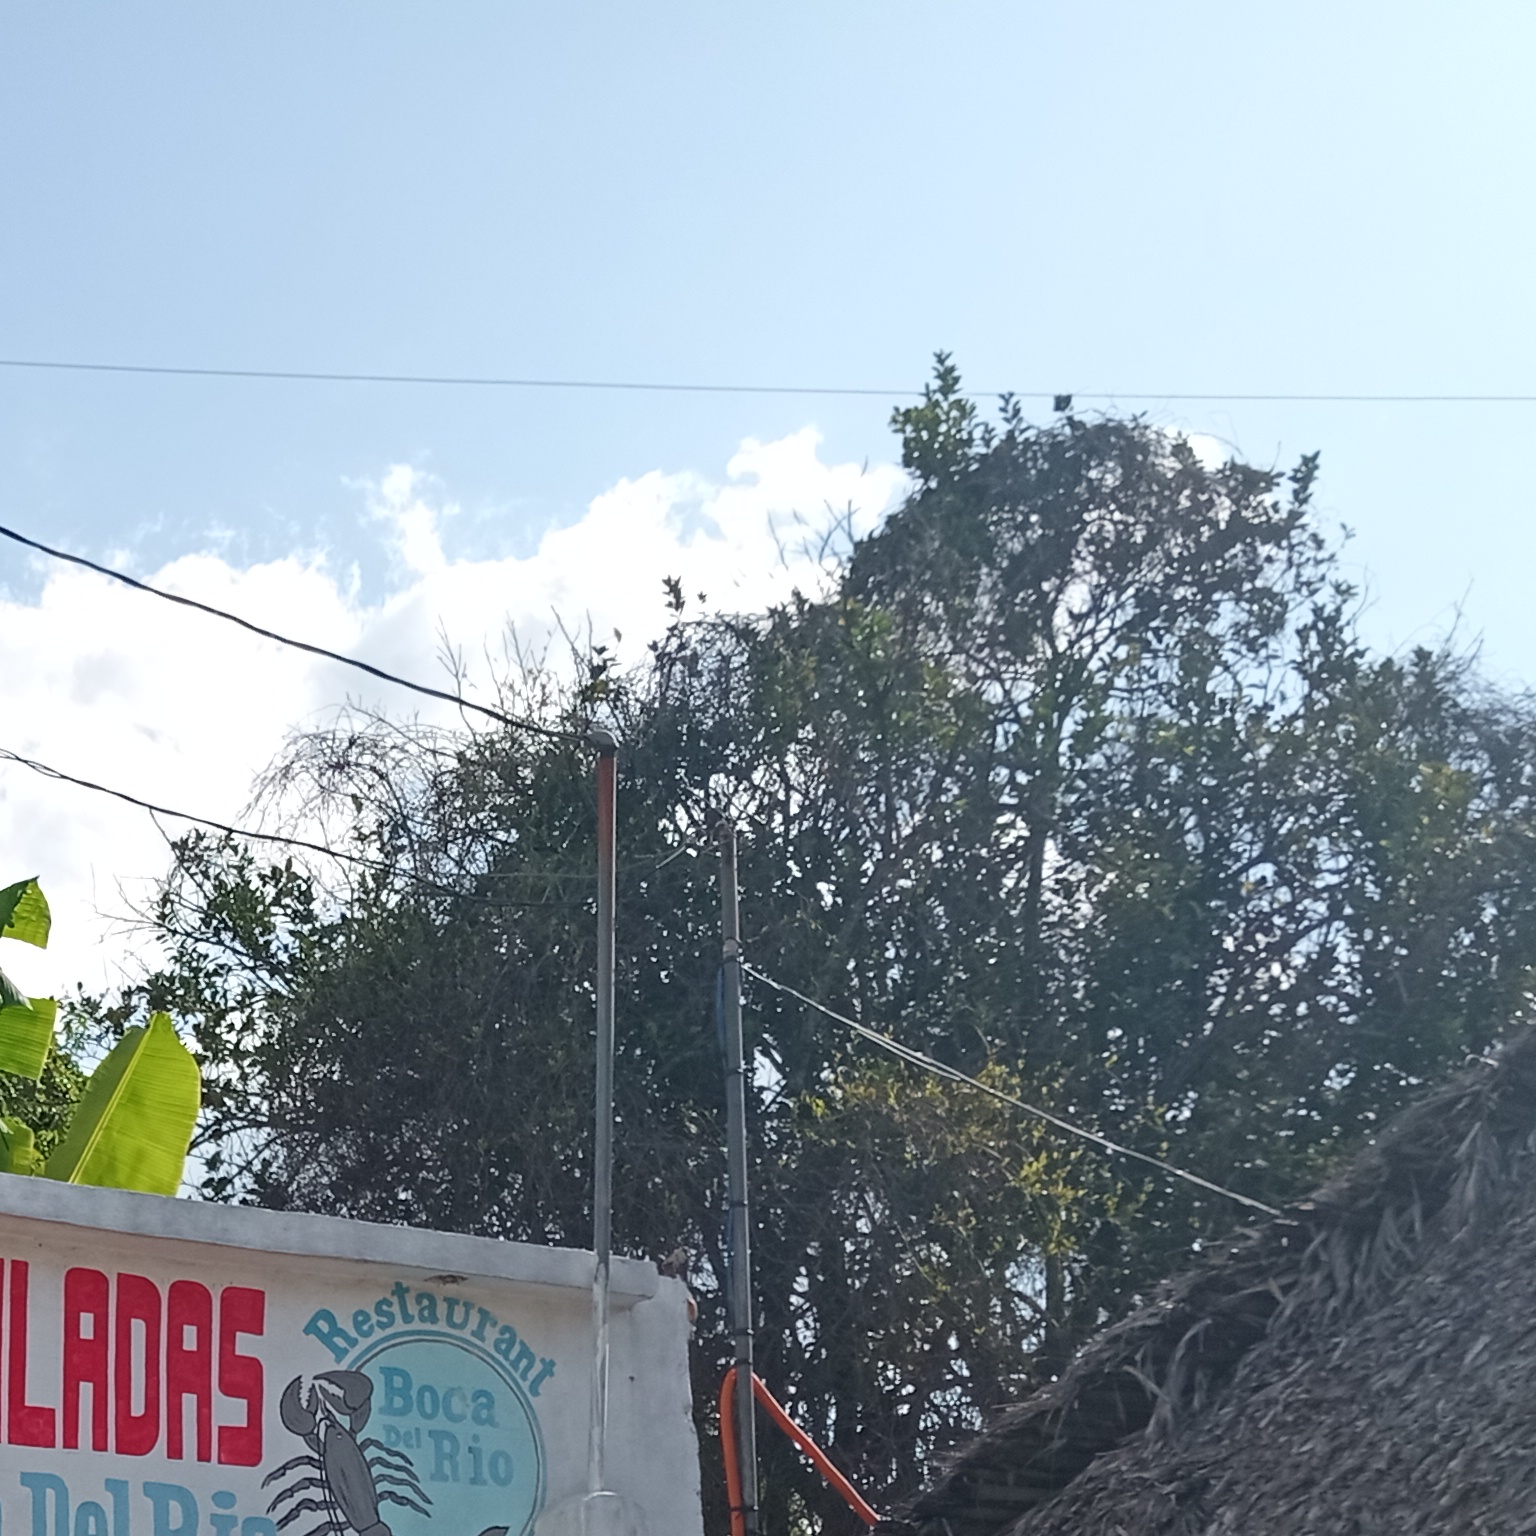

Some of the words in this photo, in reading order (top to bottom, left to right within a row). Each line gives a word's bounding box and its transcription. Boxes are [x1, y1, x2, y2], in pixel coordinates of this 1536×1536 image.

[302, 1280, 557, 1398] Restaurant
[378, 1365, 500, 1429] Boca
[382, 1423, 422, 1450] Del
[428, 1428, 515, 1488] Rio
